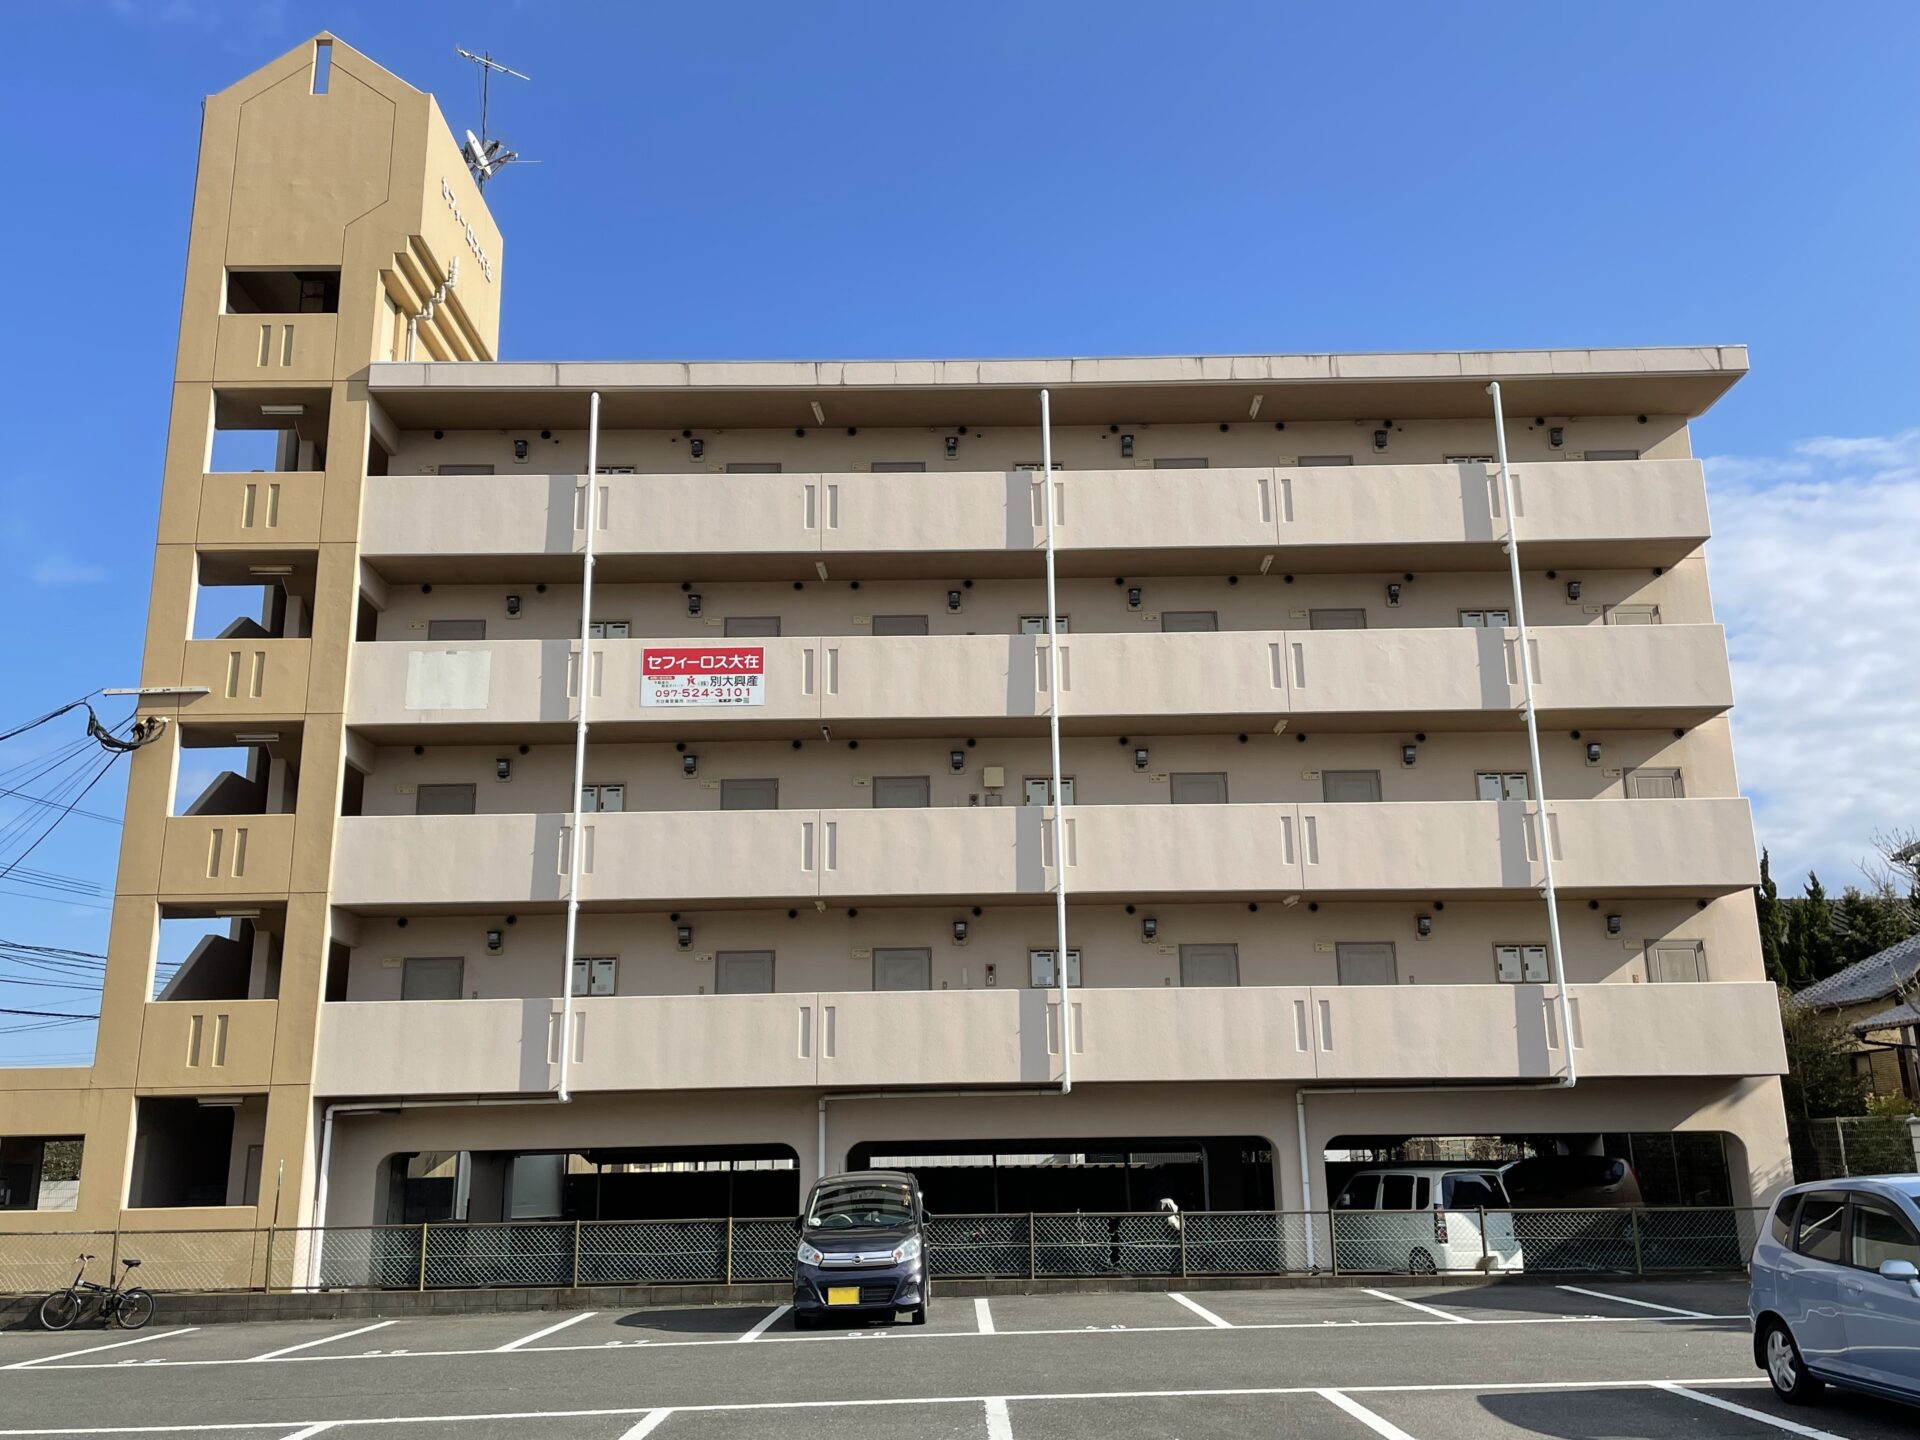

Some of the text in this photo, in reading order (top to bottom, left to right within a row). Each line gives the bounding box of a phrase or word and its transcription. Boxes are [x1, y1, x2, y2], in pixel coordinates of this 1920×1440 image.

[647, 654, 760, 670] セフィーロス大在
[655, 687, 751, 698] 097-524-3101
